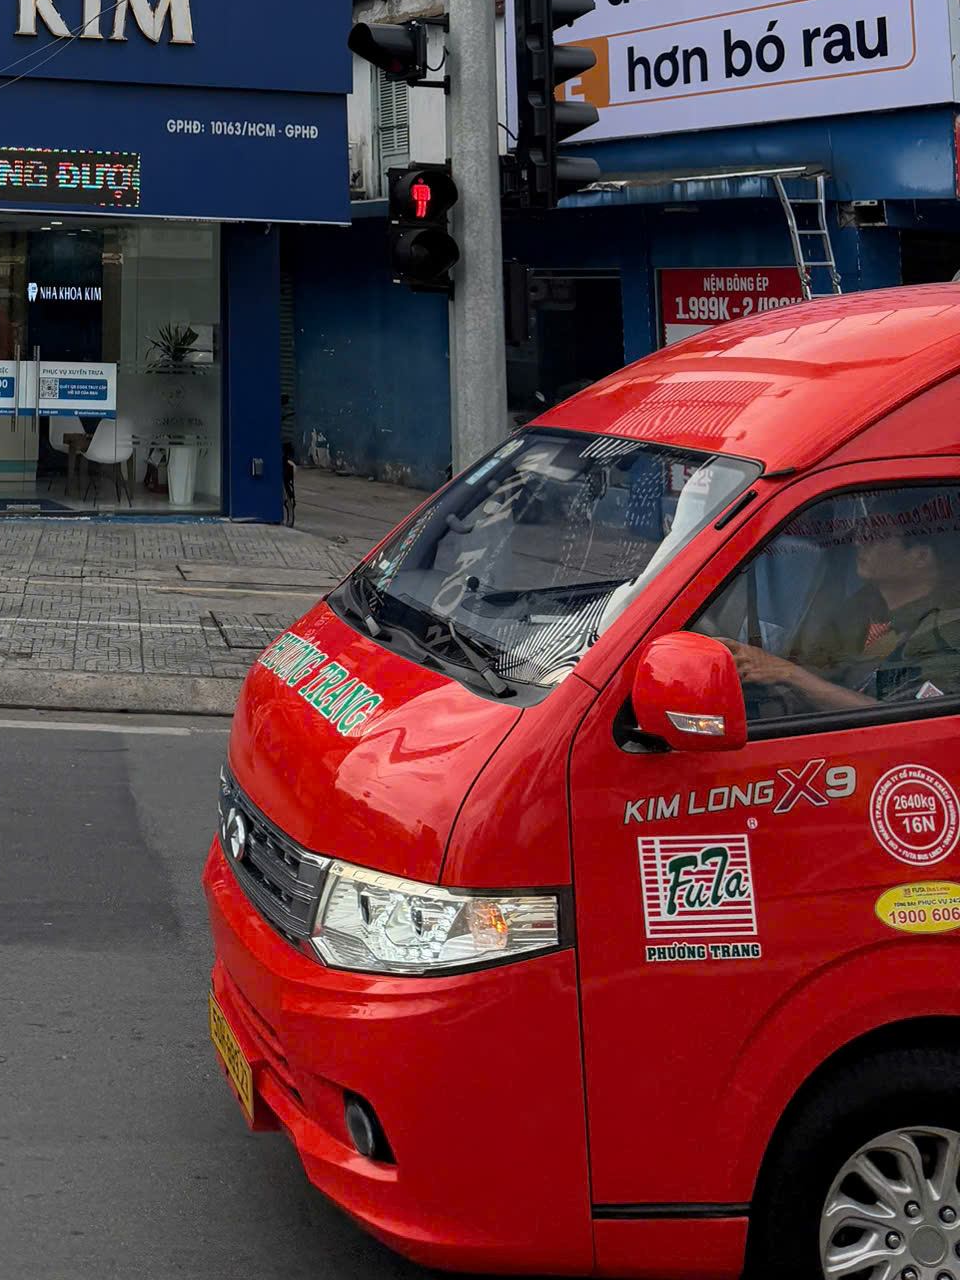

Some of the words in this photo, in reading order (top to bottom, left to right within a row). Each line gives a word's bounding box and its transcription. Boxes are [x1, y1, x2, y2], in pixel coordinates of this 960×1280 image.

[627, 41, 708, 93] hơn
[723, 20, 785, 79] bó
[802, 15, 889, 68] rau
[167, 119, 205, 134] GPHĐ:
[210, 121, 276, 137] 10163/HCM
[285, 124, 318, 139] GPHĐ
[40, 286, 58, 300] NHA
[59, 286, 82, 301] KHOA
[84, 287, 102, 301] KIM
[703, 274, 725, 295] NỆM
[726, 274, 754, 291] BÔNG
[756, 273, 769, 291] ÉP
[675, 296, 731, 320] 1.999K
[298, 661, 384, 737] TRANG
[623, 793, 681, 825] KIM
[687, 780, 775, 816] LONG
[893, 794, 936, 811] 2640kg
[902, 816, 936, 834] 16N
[888, 909, 927, 925] 1900
[708, 942, 761, 960] TRANG
